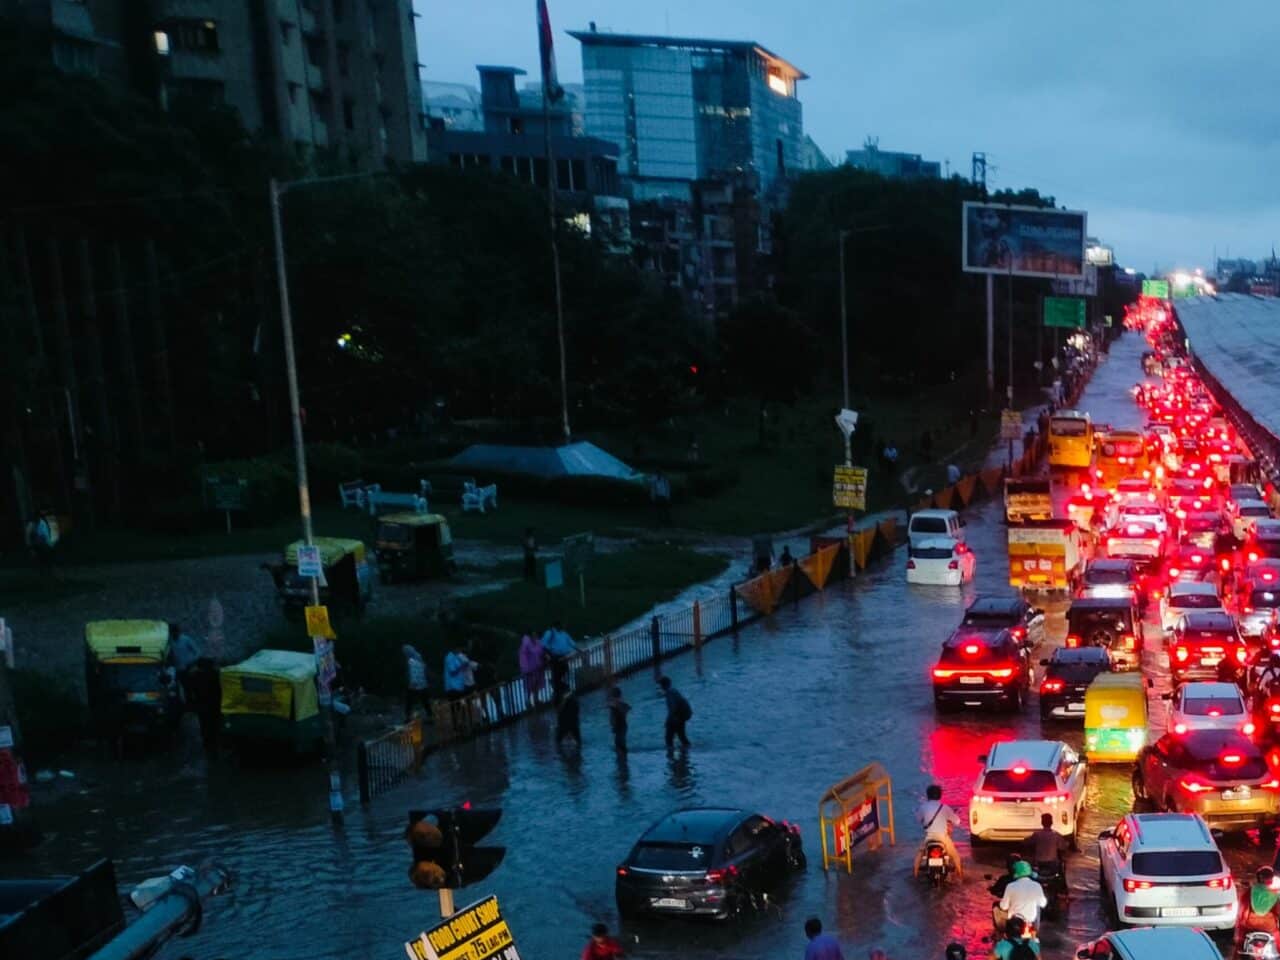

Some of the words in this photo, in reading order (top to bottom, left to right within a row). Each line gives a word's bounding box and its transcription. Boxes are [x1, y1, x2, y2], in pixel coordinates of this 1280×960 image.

[428, 925, 456, 953] FOOD
[449, 910, 481, 940] COURT
[486, 935, 500, 950] LAC
